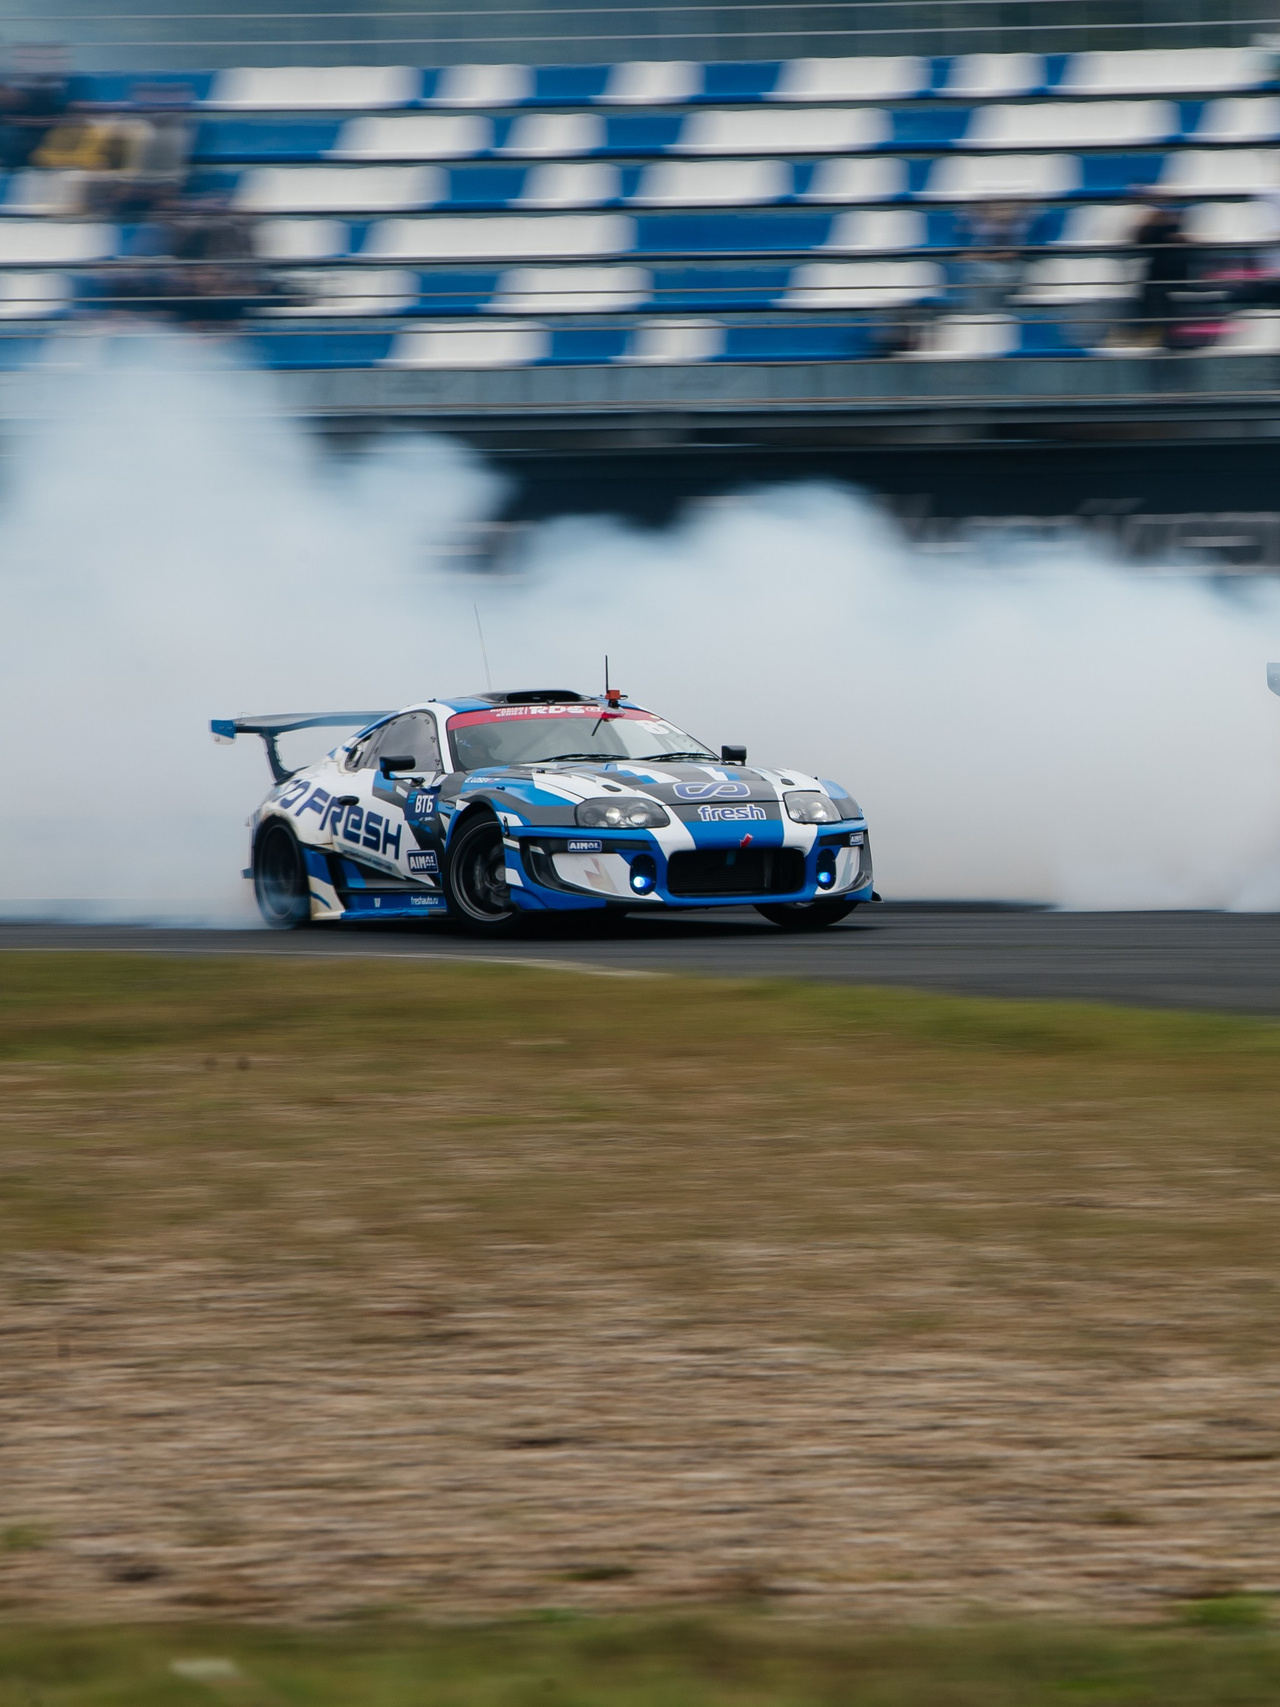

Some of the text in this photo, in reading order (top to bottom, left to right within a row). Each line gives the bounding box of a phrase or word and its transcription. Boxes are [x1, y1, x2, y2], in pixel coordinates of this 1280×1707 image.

[529, 705, 585, 715] RDS
[415, 794, 435, 813] ВТБ
[699, 804, 767, 821] fresh
